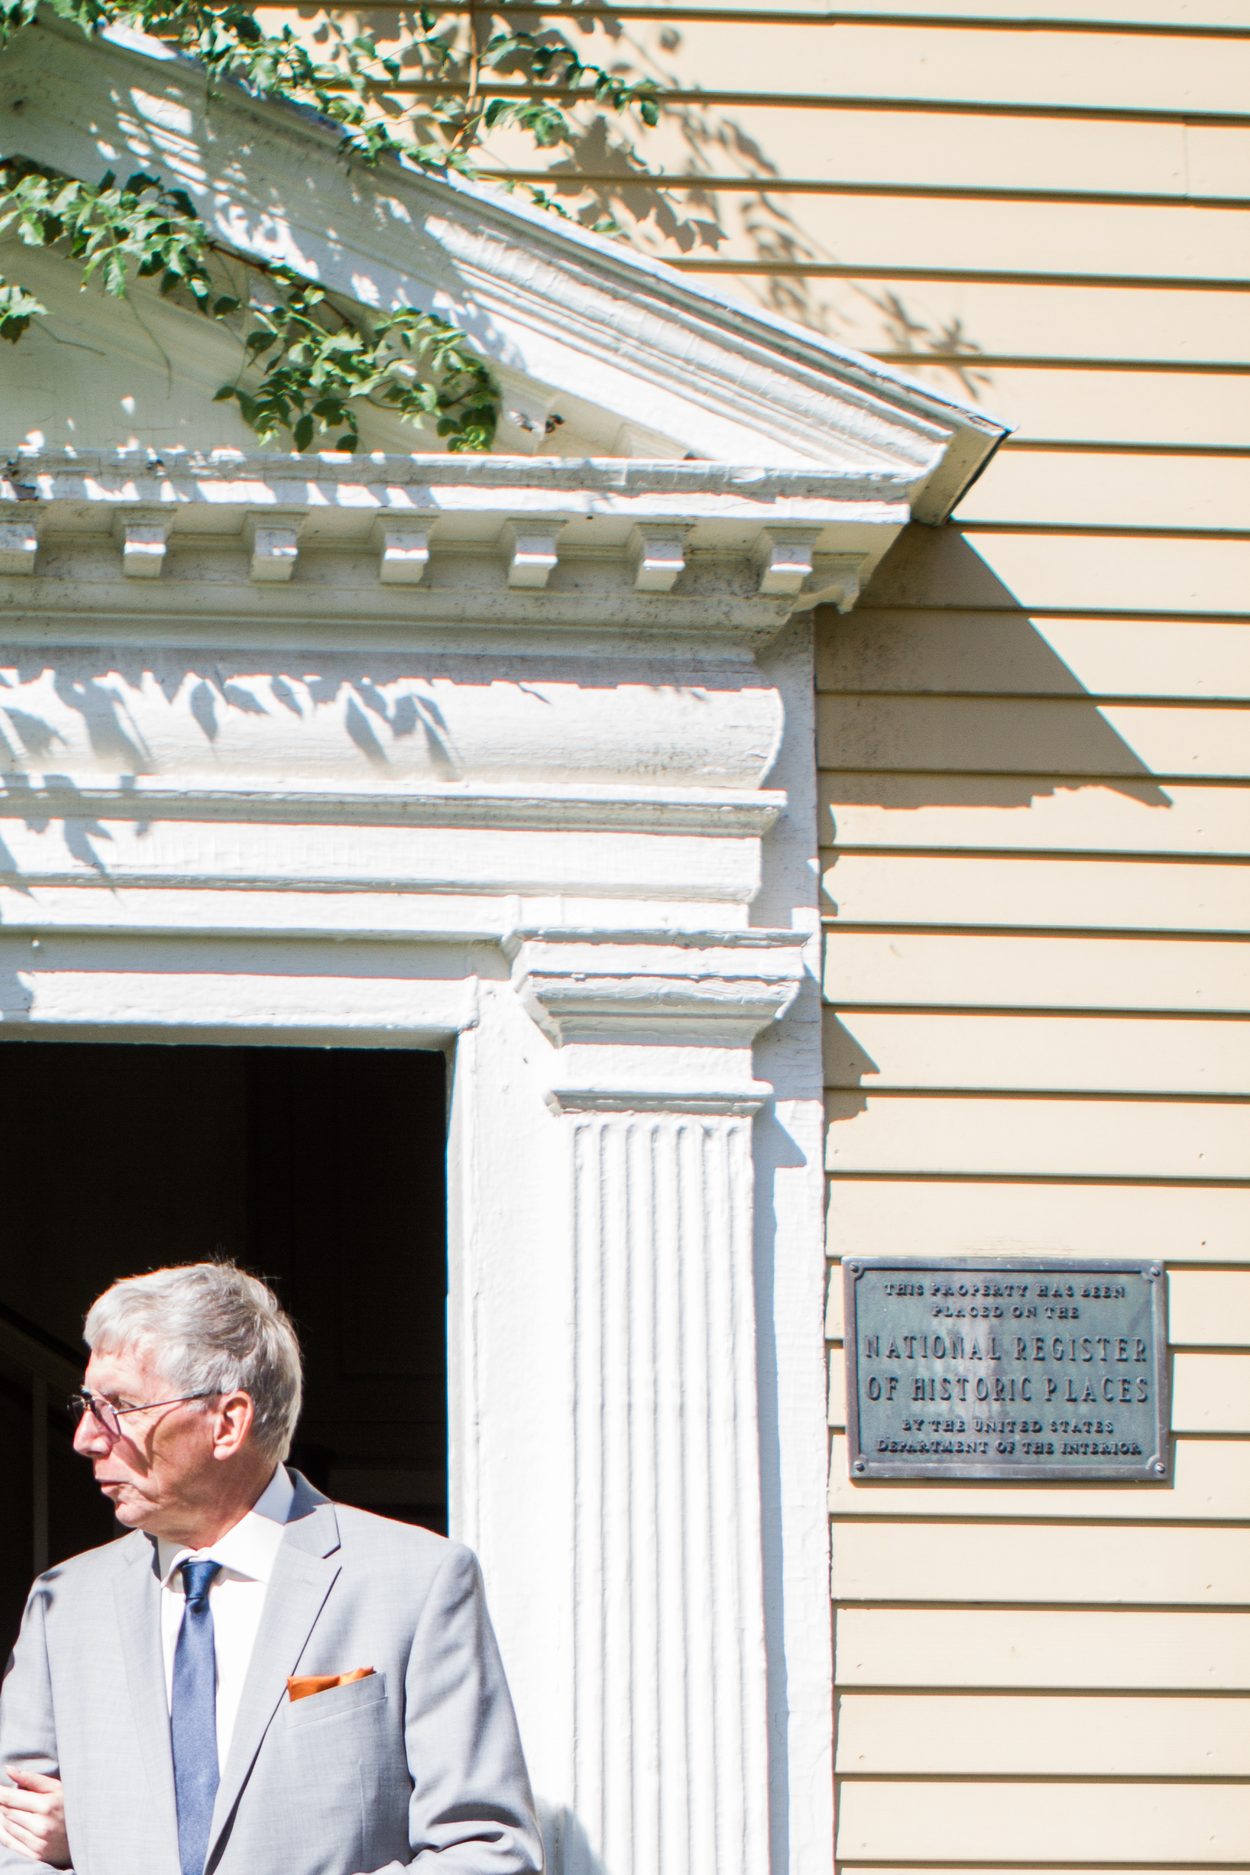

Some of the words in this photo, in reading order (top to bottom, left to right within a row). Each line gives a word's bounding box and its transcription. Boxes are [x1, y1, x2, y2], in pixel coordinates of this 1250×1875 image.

[884, 1283, 924, 1296] THIS
[930, 1283, 1029, 1297] PROPERTY
[1035, 1284, 1074, 1298] HAS
[1080, 1285, 1125, 1299] BEEN
[932, 1306, 1003, 1318] PLACED
[1012, 1306, 1037, 1318] ON
[1045, 1306, 1080, 1319] THE
[864, 1334, 1002, 1360] NATIONAL
[1013, 1336, 1148, 1363] REGISTER
[867, 1376, 899, 1401] OF
[911, 1377, 1032, 1402] HISTORIC
[1044, 1377, 1149, 1403] PLACES
[902, 1419, 924, 1432] BY
[928, 1420, 966, 1432] THE
[973, 1420, 1043, 1433] UNITED
[1049, 1421, 1114, 1434] STATES
[876, 1439, 988, 1453] DEPARTMENT
[995, 1440, 1017, 1454] OF
[1022, 1441, 1054, 1455] THE
[1060, 1442, 1142, 1456] INTERIOR
